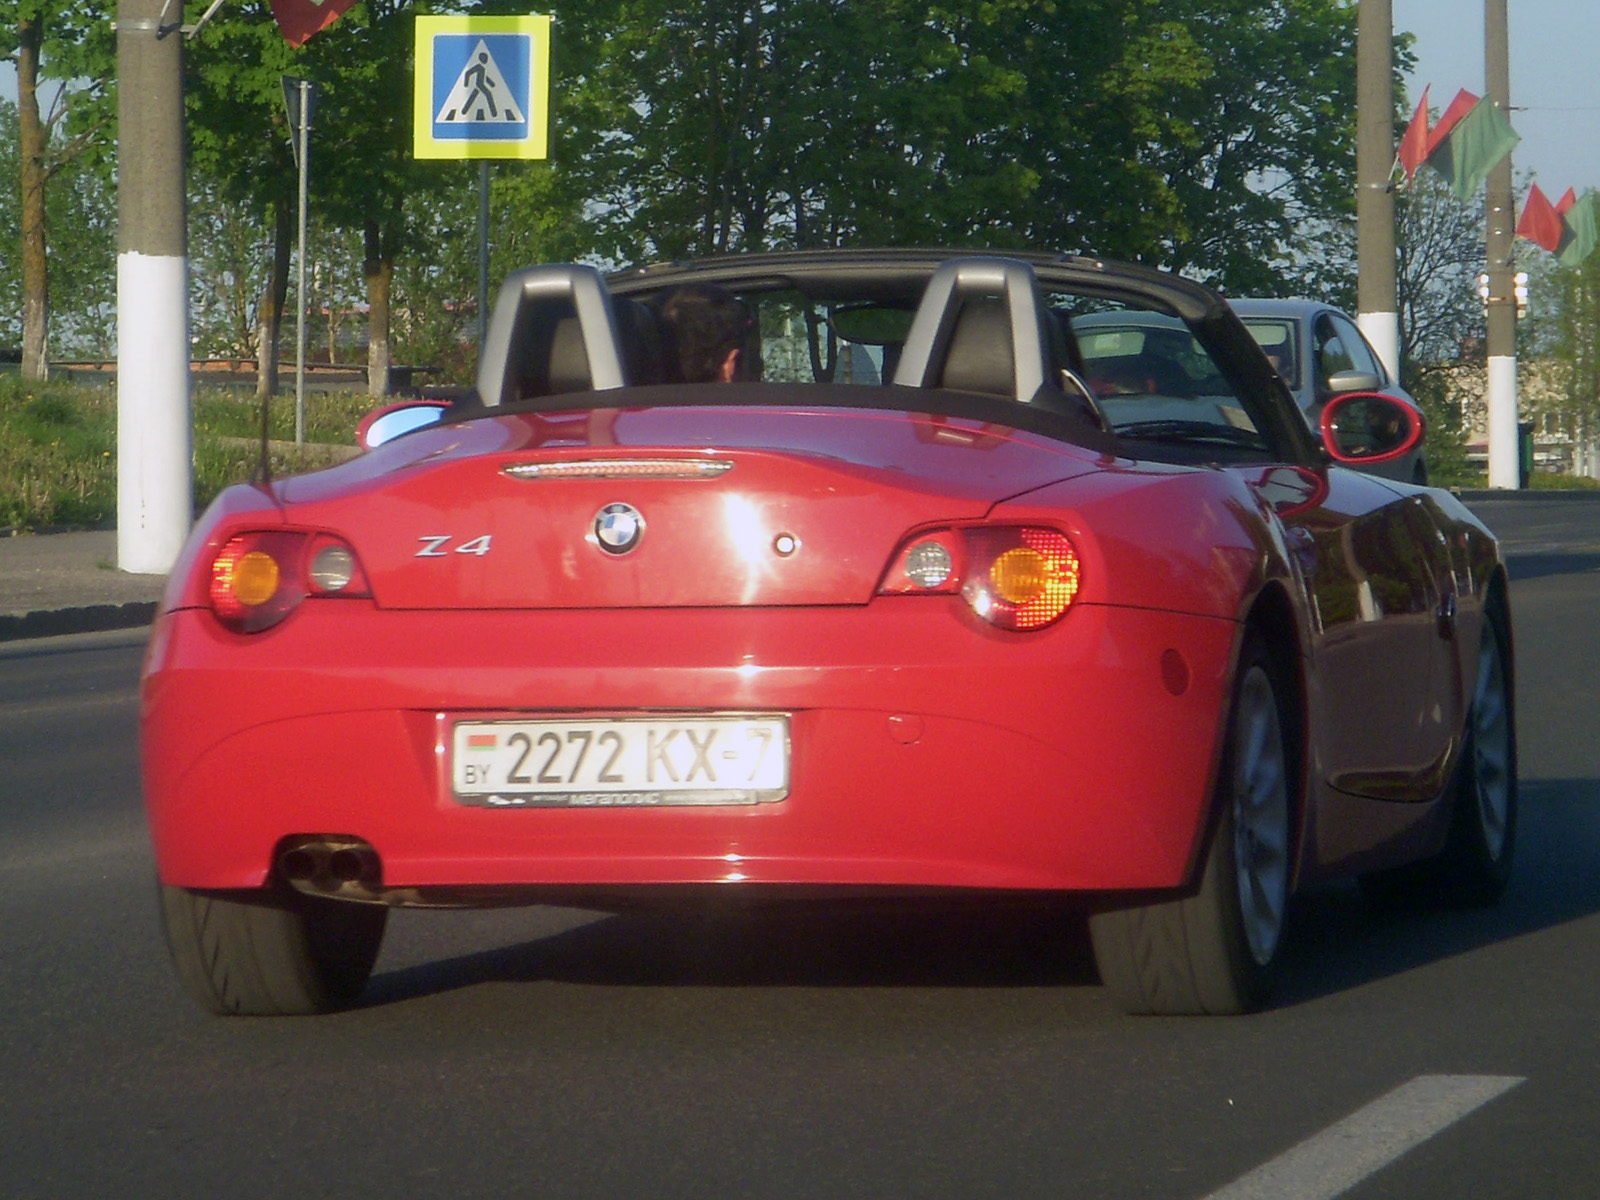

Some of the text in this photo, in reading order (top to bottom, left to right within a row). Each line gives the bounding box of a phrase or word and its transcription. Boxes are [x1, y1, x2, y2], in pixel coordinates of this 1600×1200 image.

[465, 764, 491, 785] BY
[507, 727, 773, 784] 2272 KX-7
